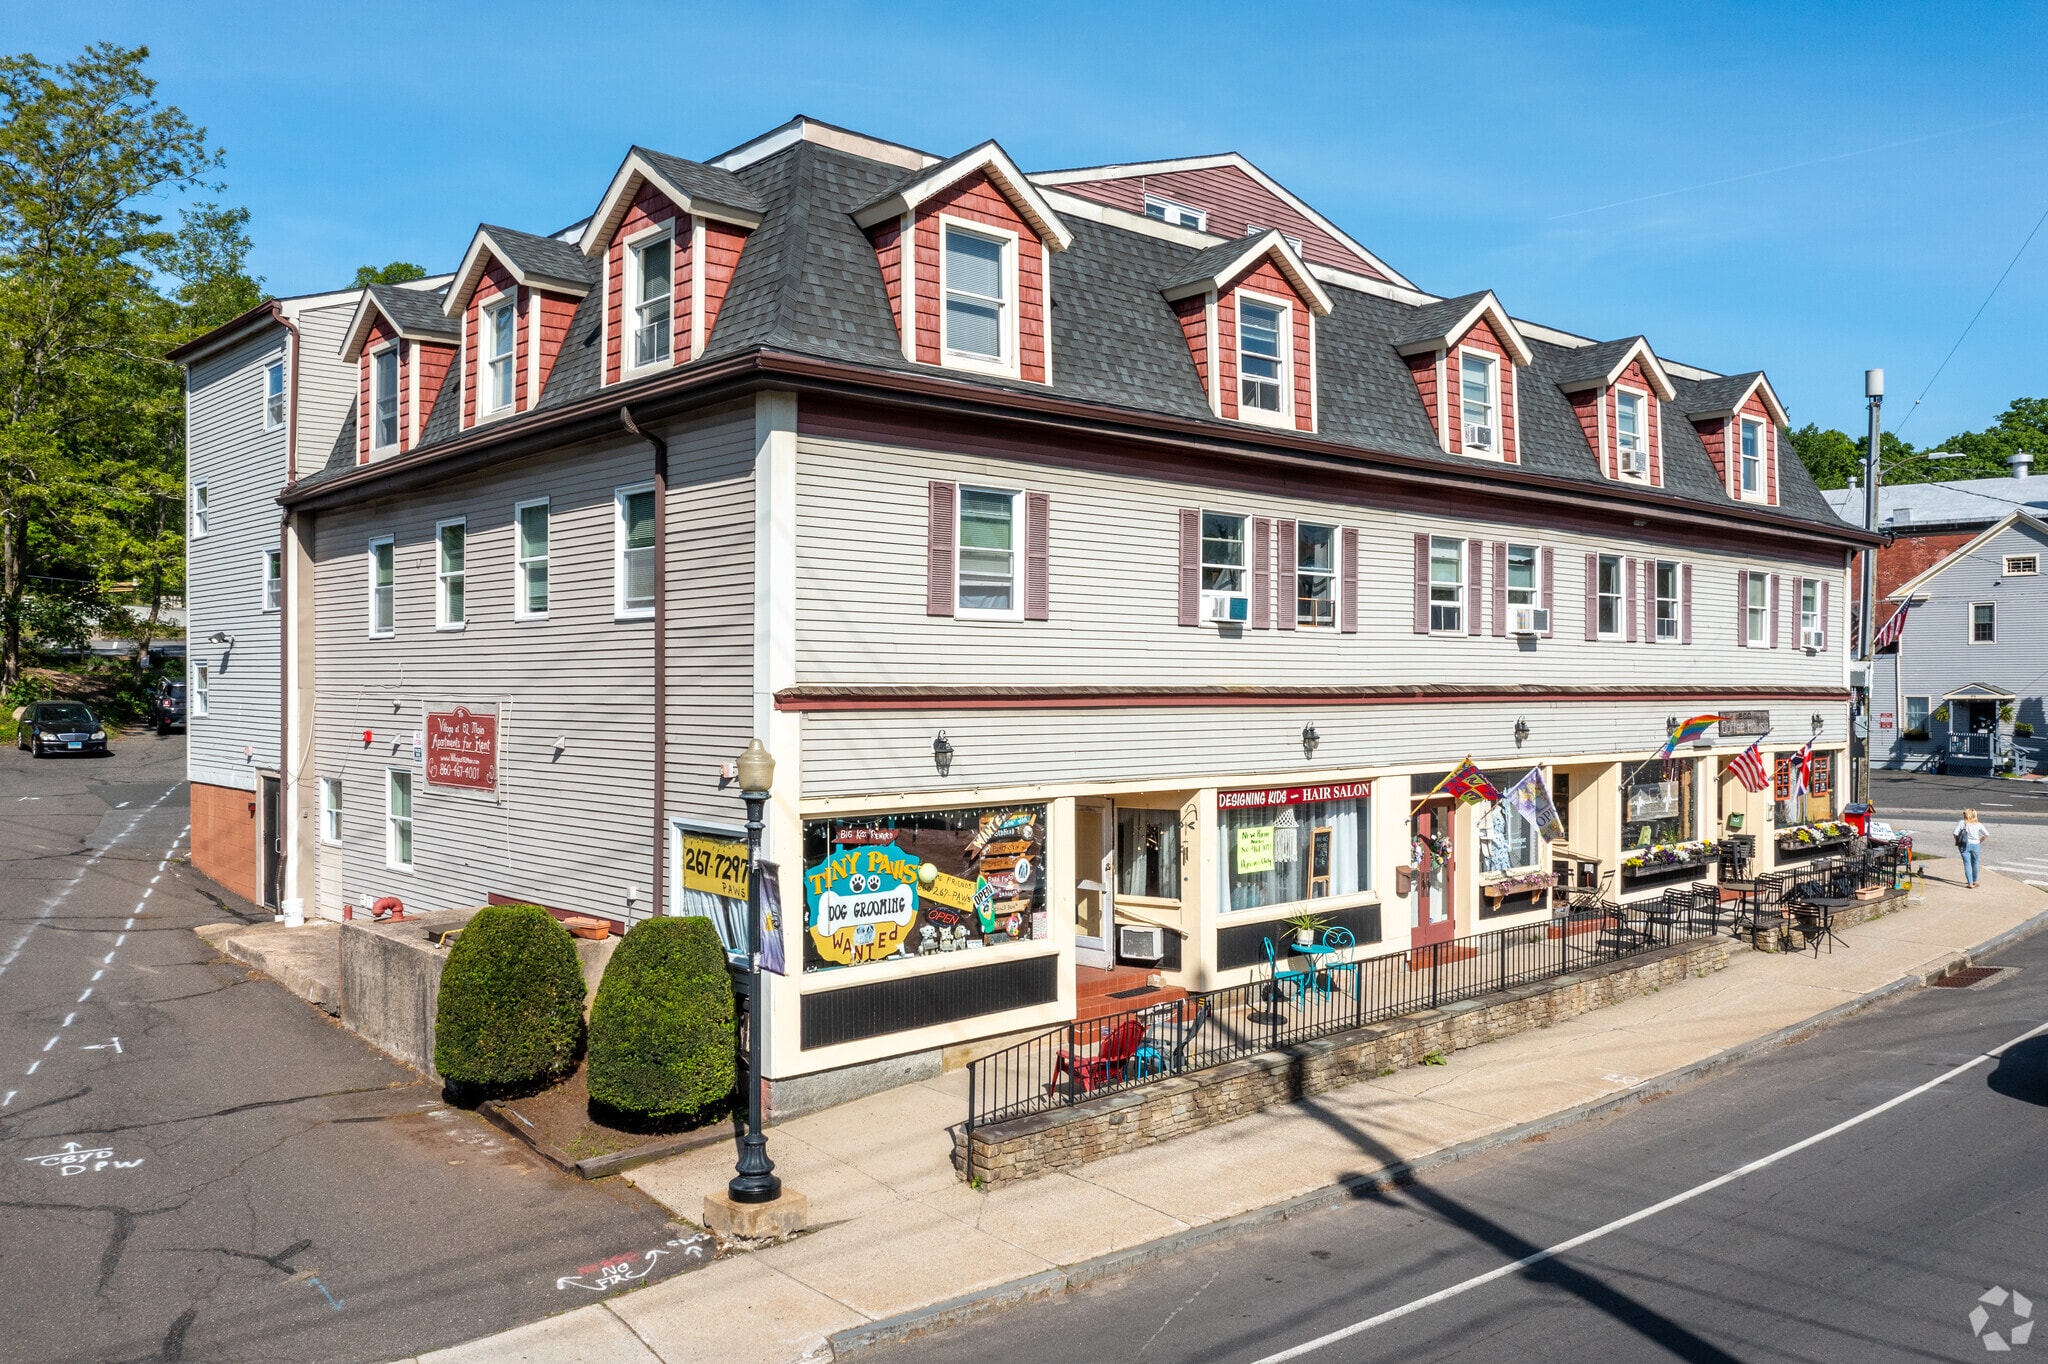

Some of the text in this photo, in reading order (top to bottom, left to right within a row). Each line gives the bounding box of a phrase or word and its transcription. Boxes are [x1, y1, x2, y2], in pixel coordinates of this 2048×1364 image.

[437, 718, 454, 737] Village
[471, 721, 485, 735] Main
[431, 733, 461, 751] Apartments
[462, 736, 472, 752] for
[474, 734, 491, 754] Rent
[439, 762, 480, 780] 860-467-4001
[1218, 791, 1266, 808] DESIGNING
[1268, 790, 1287, 805] KIDS
[1302, 786, 1332, 802] HAIR
[1333, 783, 1370, 799] SALON
[840, 829, 853, 839] BIG
[685, 847, 749, 884] 267-7297
[808, 851, 861, 895] TINY
[867, 851, 918, 884] PAWS
[721, 881, 746, 899] PAWS
[973, 884, 994, 906] OPEN
[828, 897, 906, 922] DOG GROOMING
[928, 909, 960, 926] OPEN
[40, 1150, 114, 1167] CBYD
[601, 1262, 630, 1278] NO
